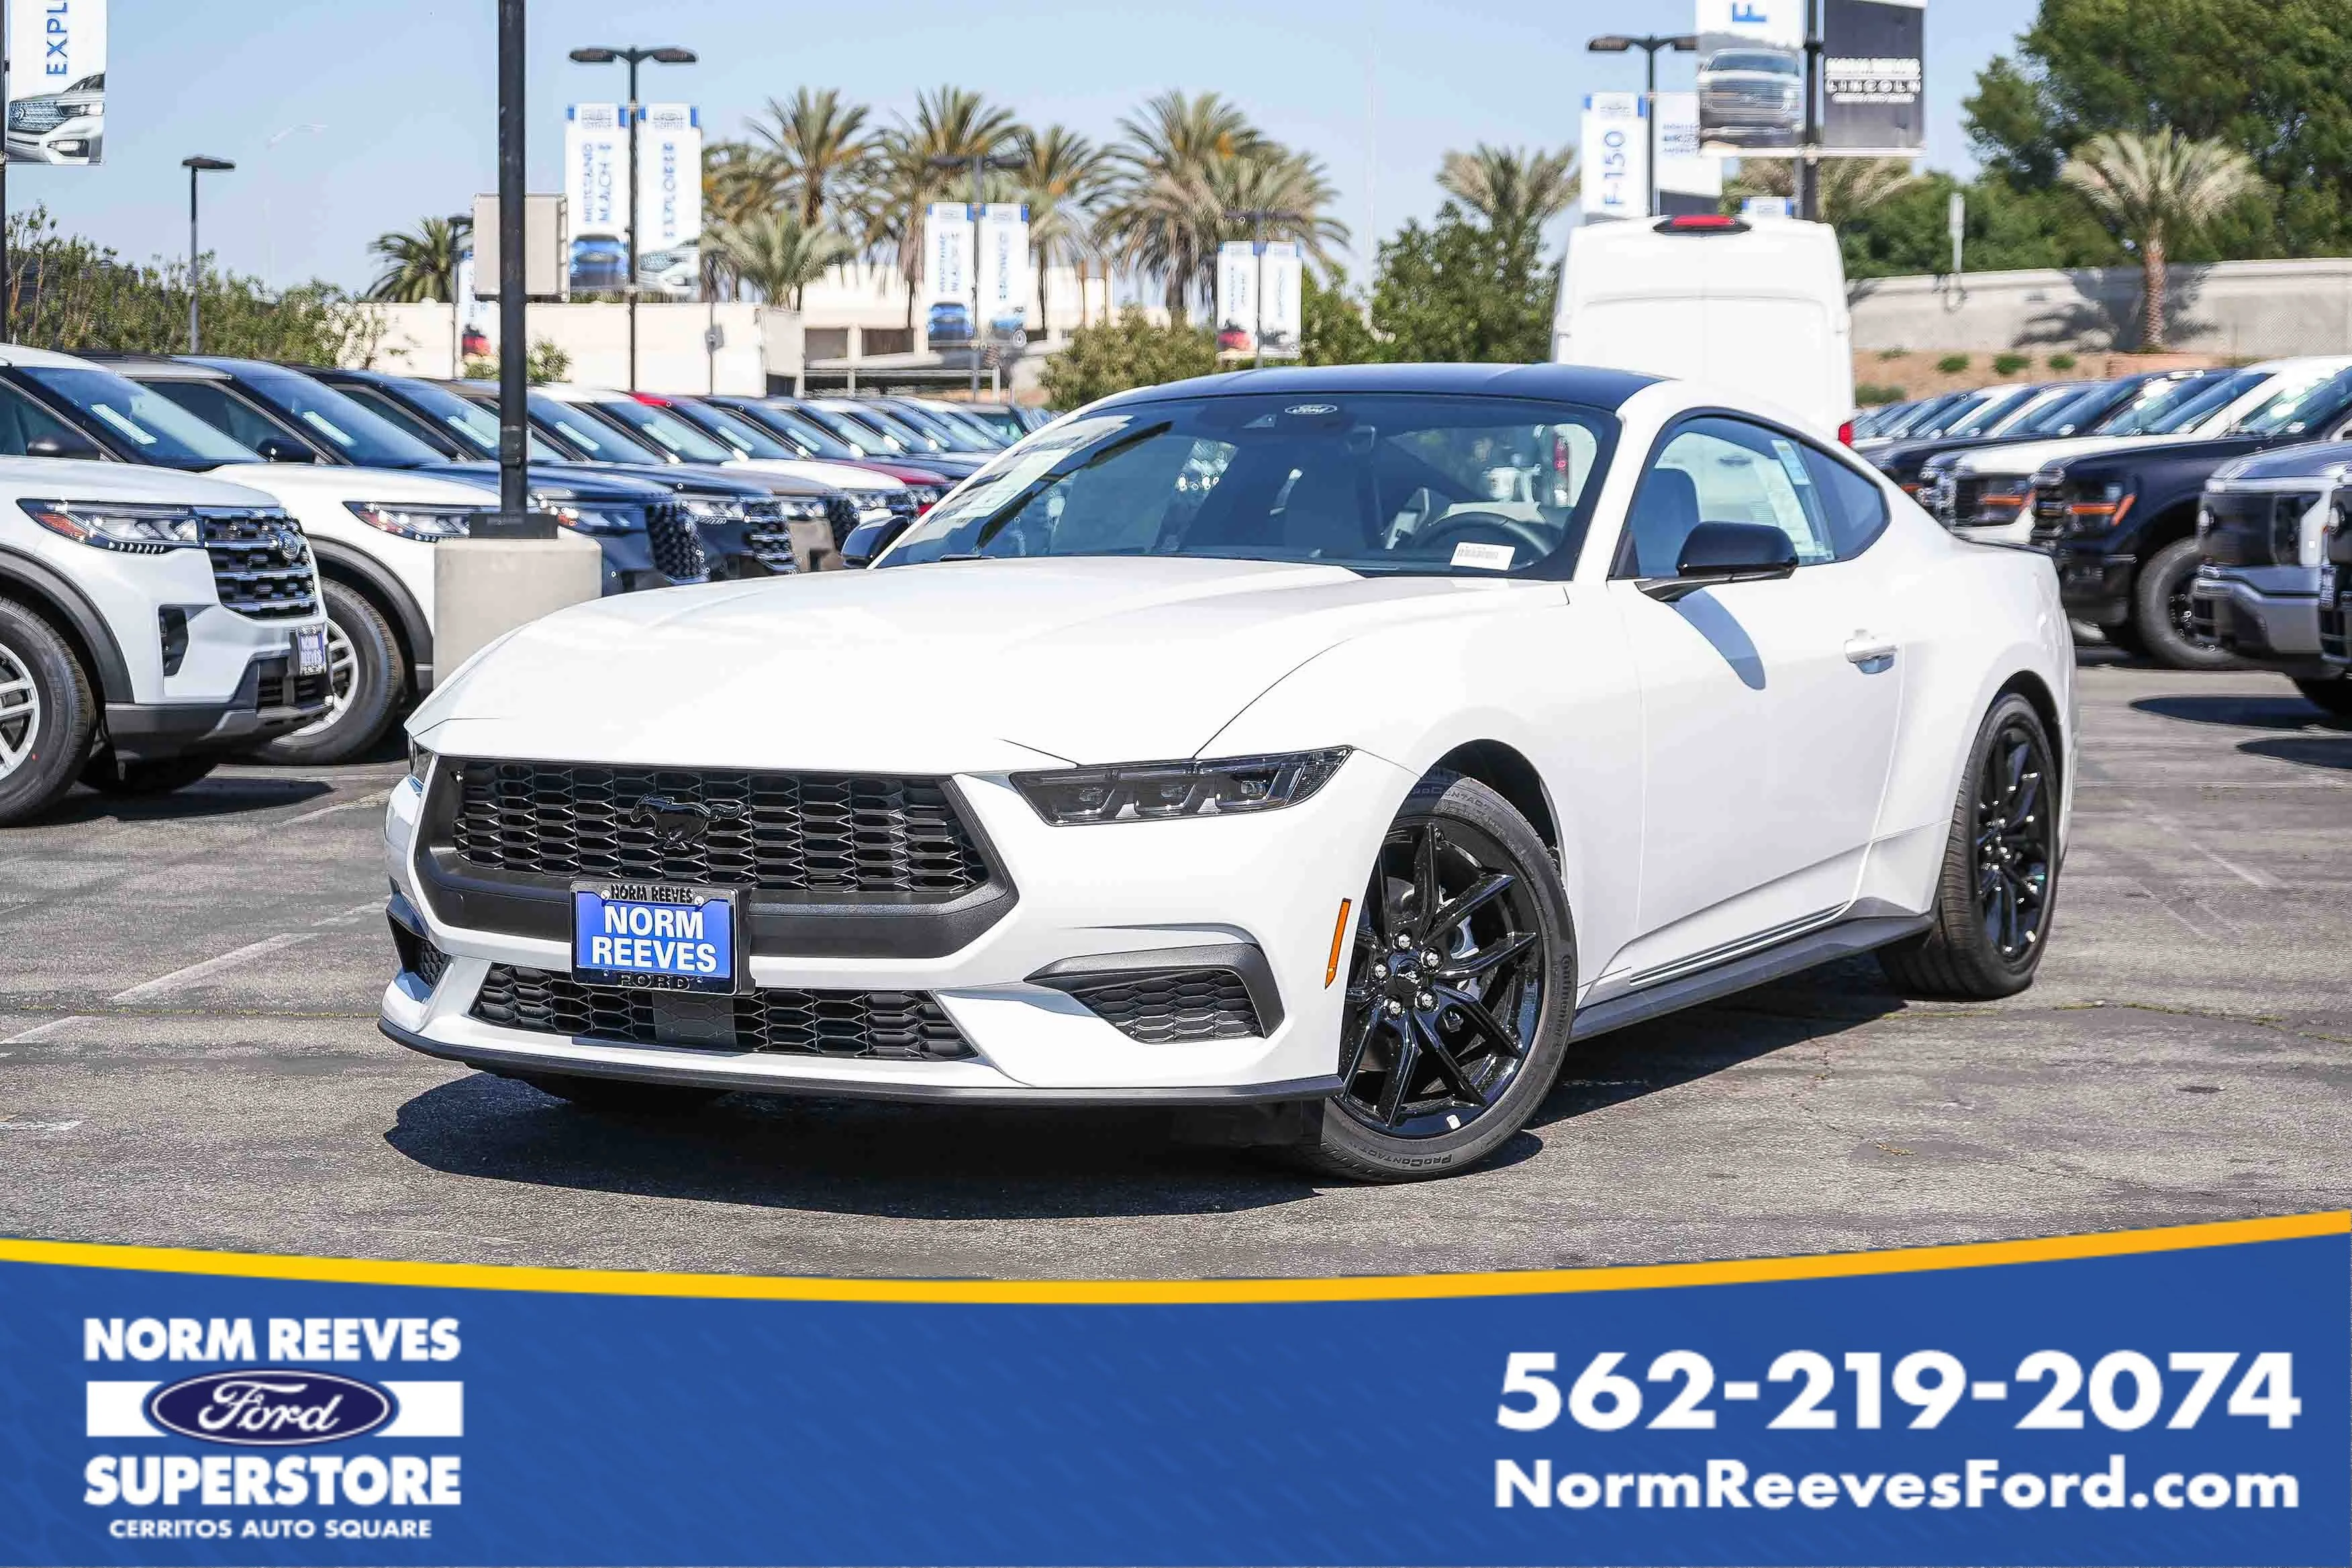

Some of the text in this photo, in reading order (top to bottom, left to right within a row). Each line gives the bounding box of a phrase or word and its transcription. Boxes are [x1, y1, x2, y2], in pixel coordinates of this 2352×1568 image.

[1732, 3, 1767, 23] F
[46, 0, 68, 75] EXPL
[1604, 130, 1626, 205] F-150
[611, 884, 694, 903] NORM REEVES
[604, 905, 704, 940] NORM
[591, 936, 718, 973] REEVES
[618, 972, 690, 990] FORD
[1555, 954, 1573, 1038] Continental
